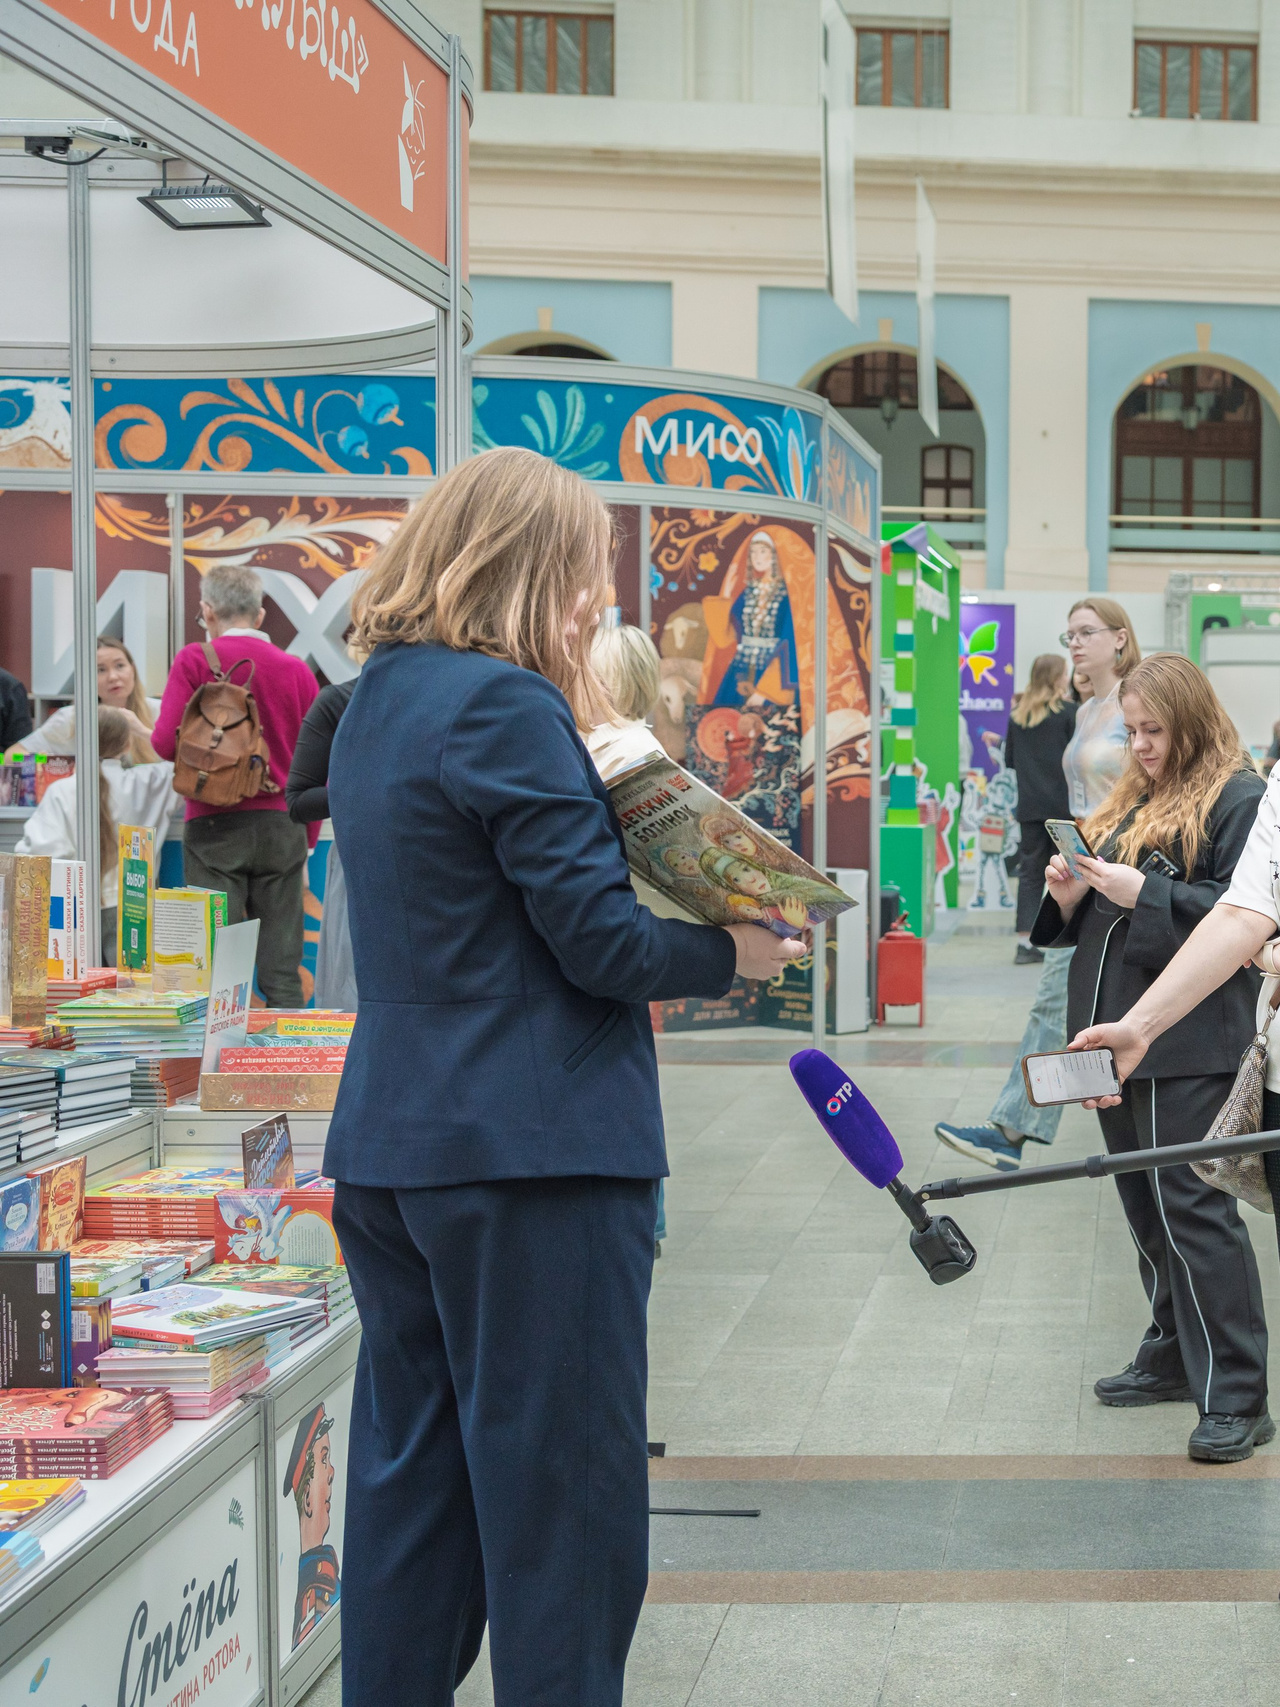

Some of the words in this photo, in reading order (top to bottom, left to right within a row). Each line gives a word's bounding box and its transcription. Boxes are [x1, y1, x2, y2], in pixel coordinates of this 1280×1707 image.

[110, 0, 200, 77] ОДА
[634, 415, 763, 465] МИФ
[619, 787, 680, 832] ДЕТСКИЙ
[632, 804, 700, 844] БОТИНОК
[126, 872, 146, 888] ВЫБОР
[166, 1674, 201, 1707] ТИНА
[202, 1631, 241, 1691] РОТОВА
